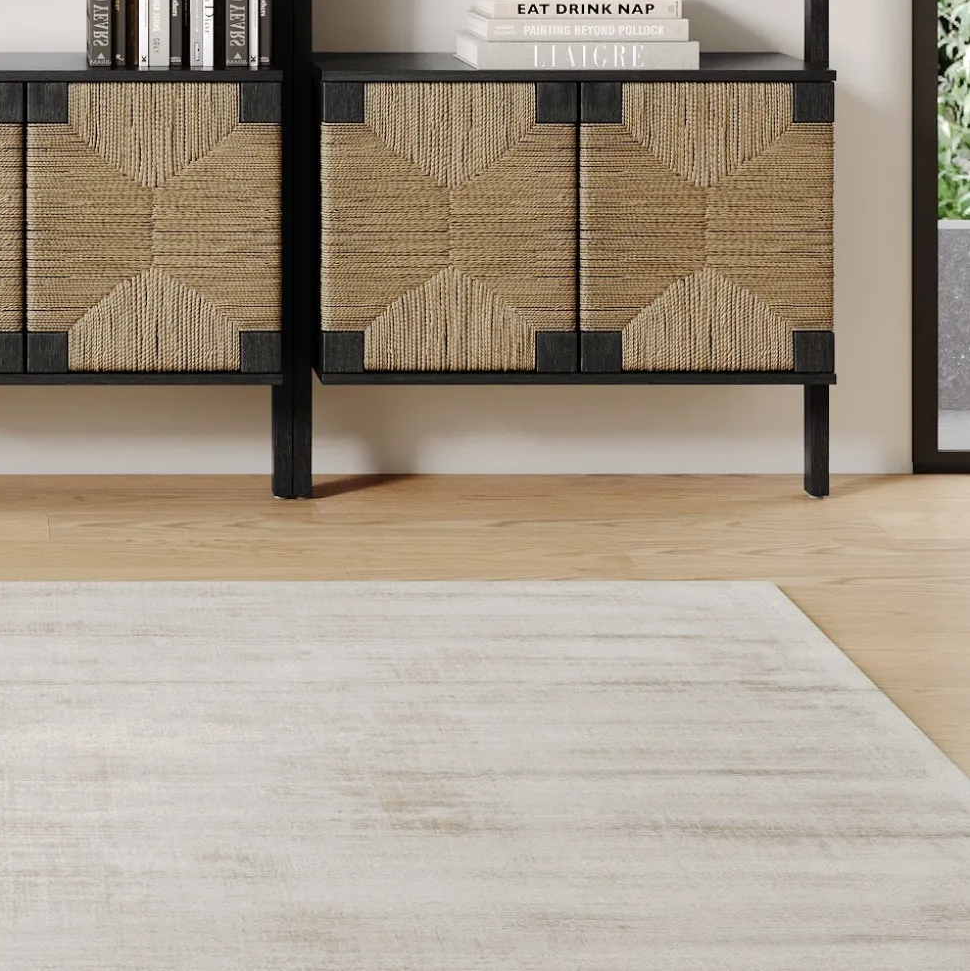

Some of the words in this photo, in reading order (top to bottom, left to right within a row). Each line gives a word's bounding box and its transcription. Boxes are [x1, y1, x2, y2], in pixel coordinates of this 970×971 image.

[517, 3, 550, 15] EAT
[555, 3, 612, 15] DRINK
[618, 3, 655, 15] NAP
[204, 5, 215, 35] Dior
[524, 25, 572, 36] PAINTING
[574, 25, 616, 36] BEYOND
[618, 25, 665, 36] POLLOCK
[152, 37, 160, 53] GRAY
[533, 44, 645, 68] LIAIGRE
